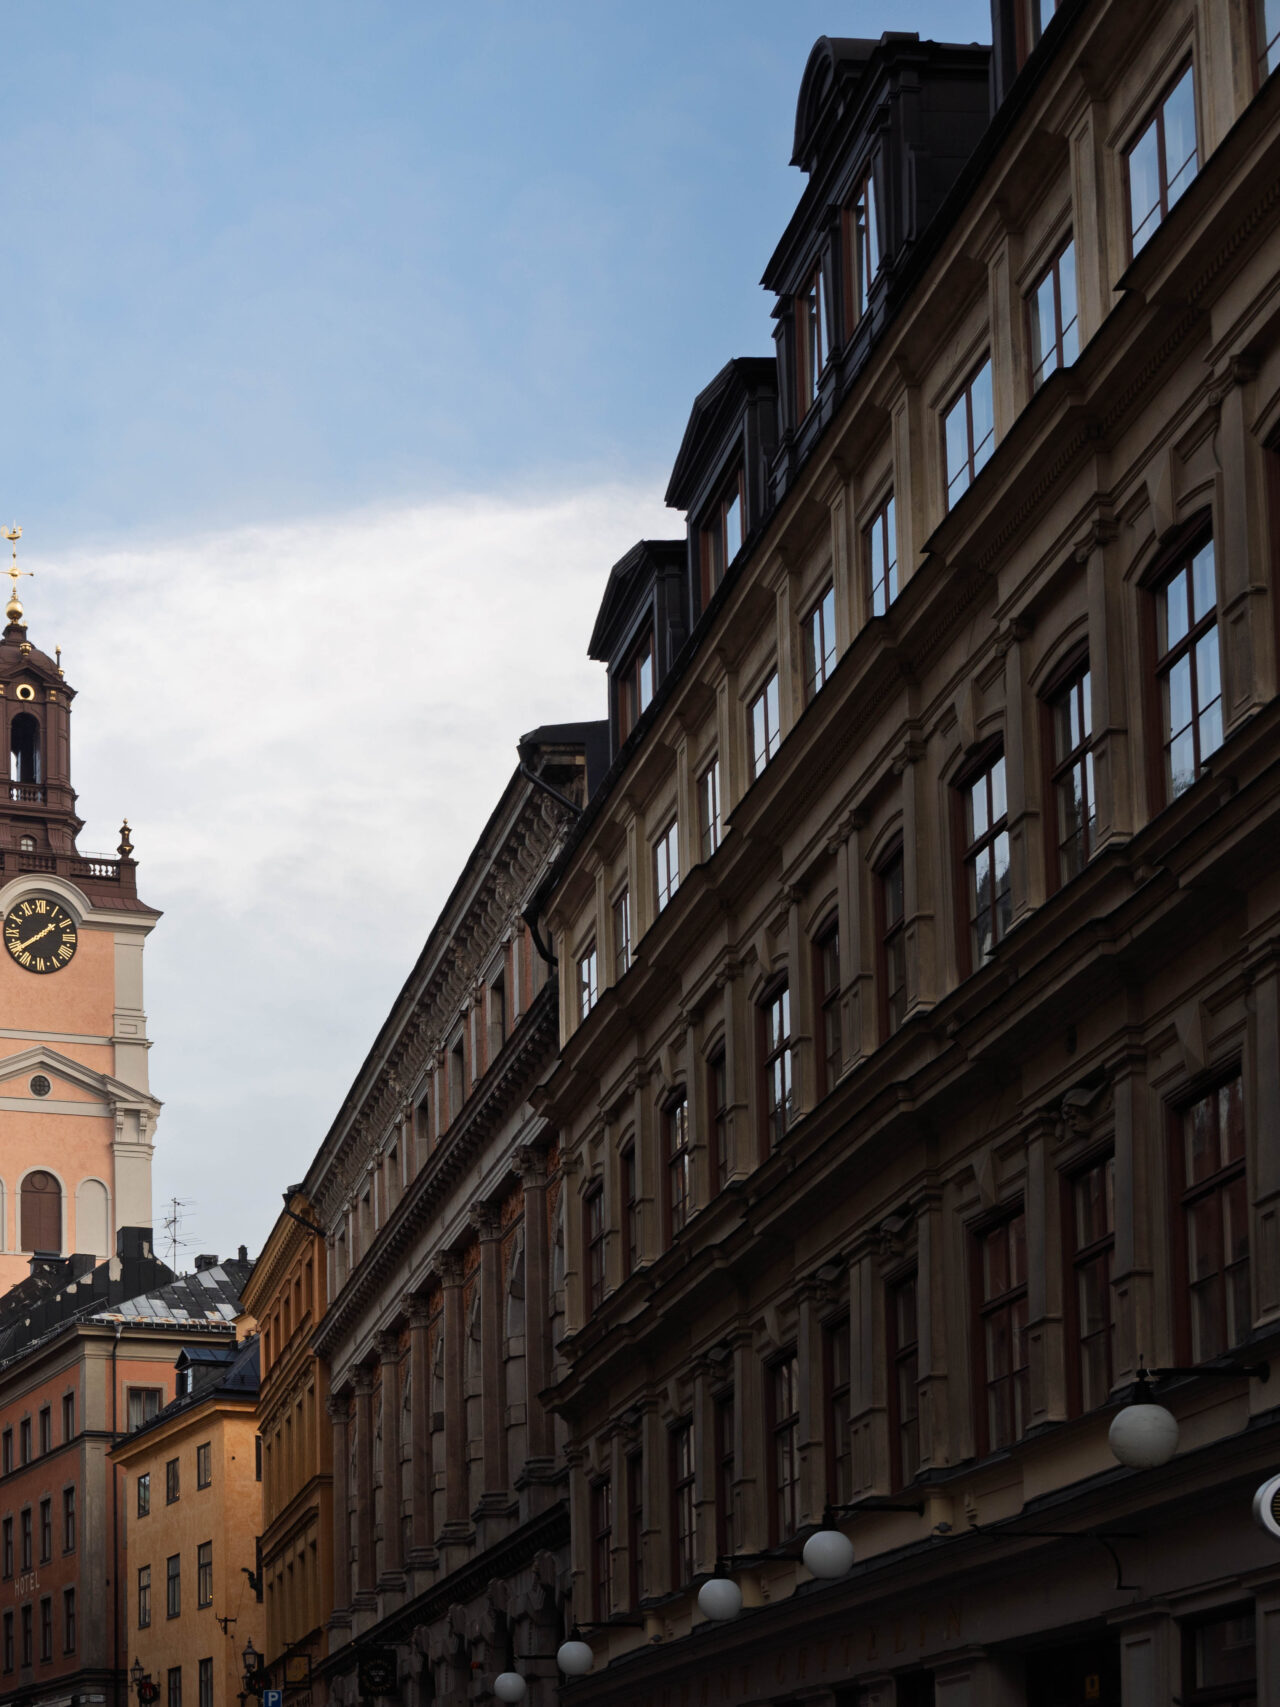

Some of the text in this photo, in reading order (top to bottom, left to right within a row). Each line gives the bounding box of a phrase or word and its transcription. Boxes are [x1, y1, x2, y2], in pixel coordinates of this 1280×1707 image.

[20, 901, 33, 917] XI
[35, 899, 47, 914] XII
[50, 905, 59, 918] I
[9, 912, 23, 925] X
[58, 917, 73, 929] II
[5, 927, 20, 938] IX
[62, 933, 76, 943] III
[14, 1570, 41, 1597] HOTEL
[268, 1691, 279, 1707] P
